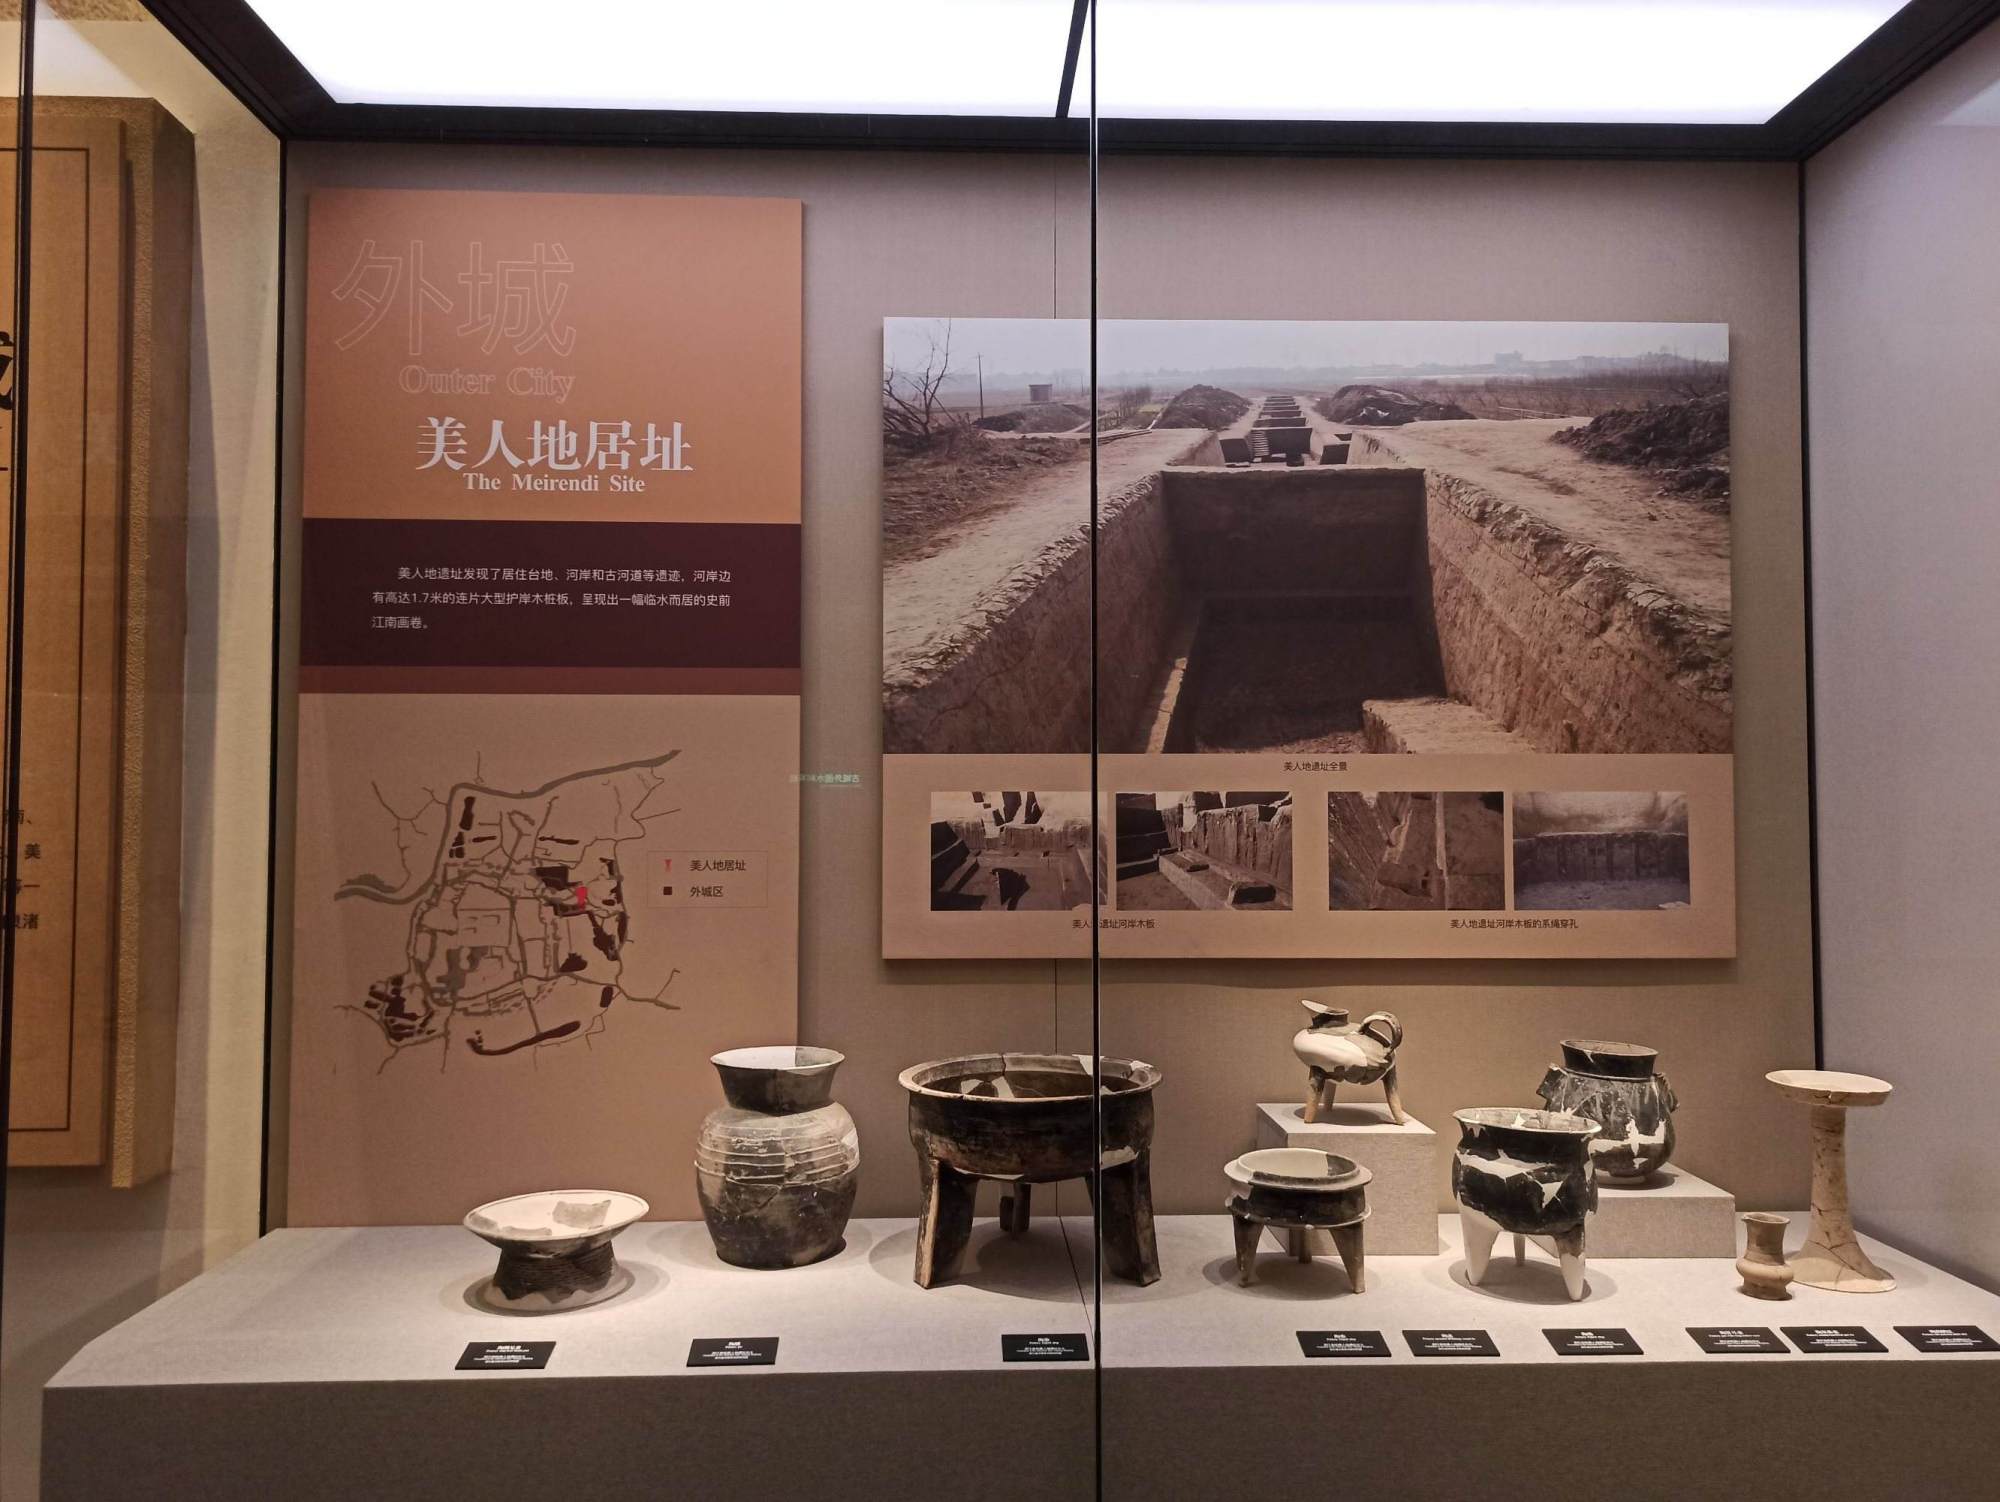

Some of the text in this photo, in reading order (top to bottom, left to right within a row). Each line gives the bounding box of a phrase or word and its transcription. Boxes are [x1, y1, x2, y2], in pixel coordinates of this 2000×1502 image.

[331, 238, 577, 357] 外城
[400, 364, 577, 405] Outer City
[415, 416, 695, 472] 美人地居址
[463, 472, 646, 493] The Meirendi Site
[371, 616, 429, 630] 江南画卷。
[690, 859, 747, 872] 美人地居址
[689, 885, 724, 898] 外城区
[1072, 919, 1155, 929] 美人遗址河岸木板
